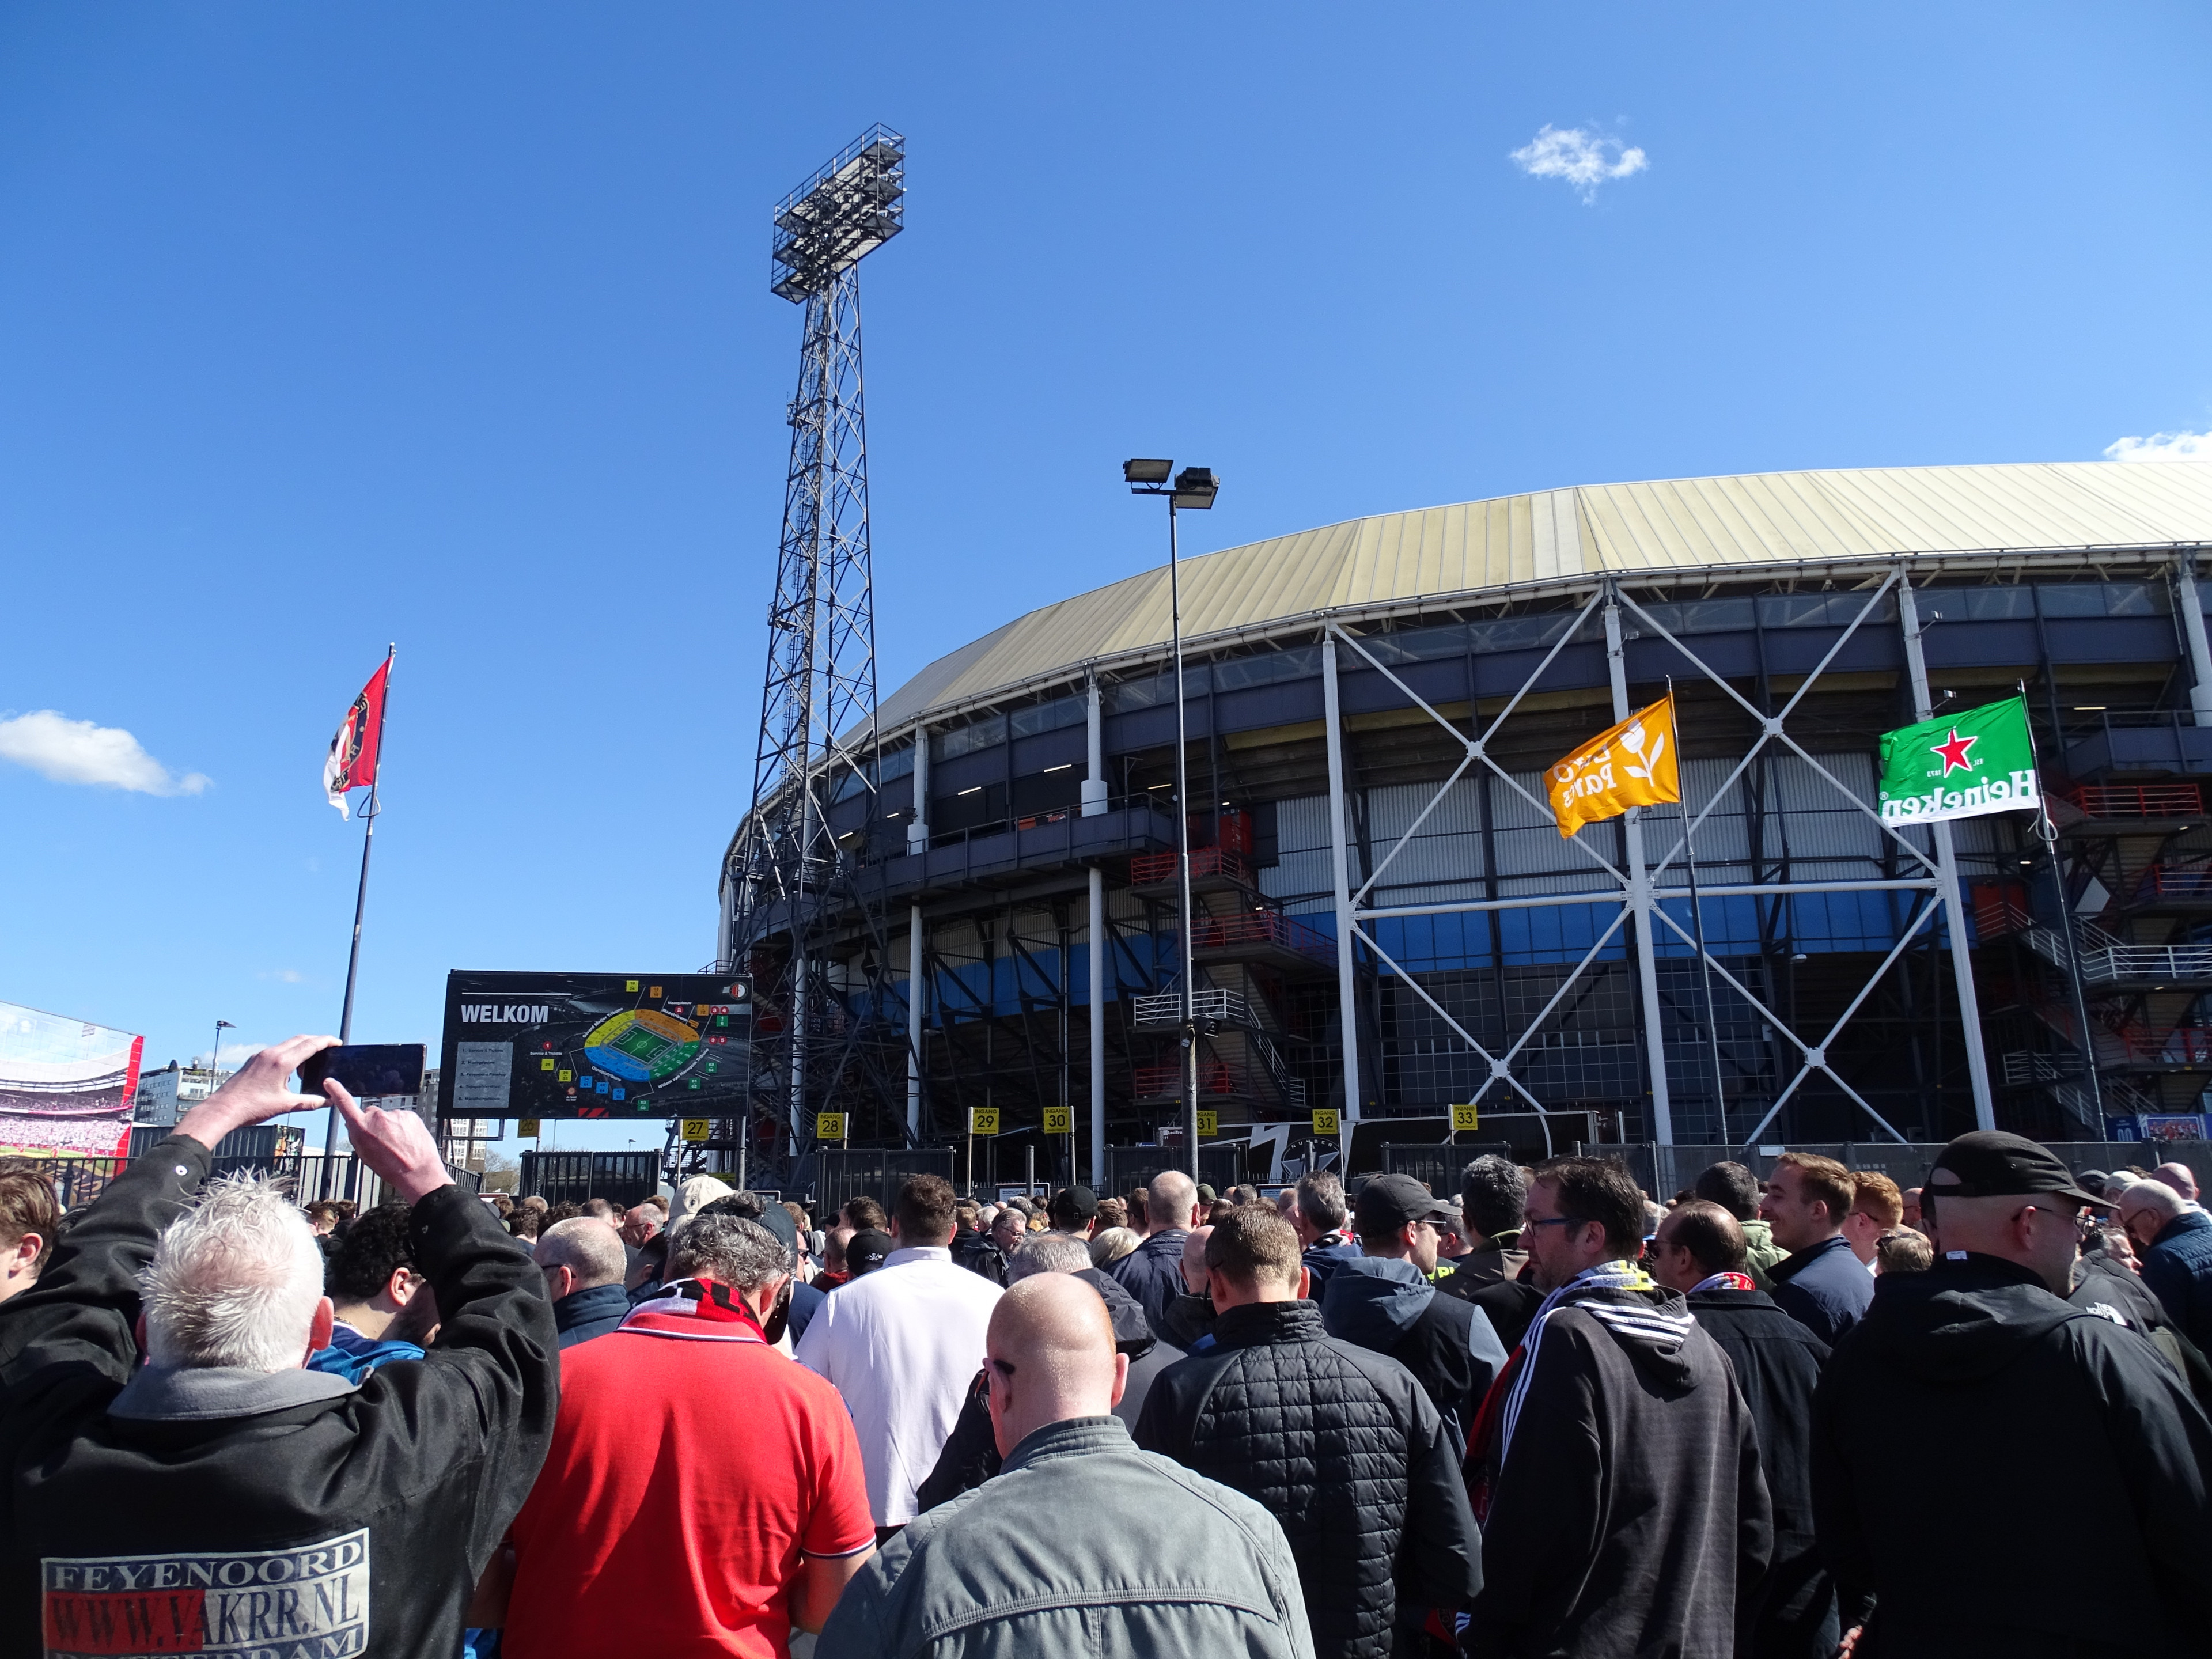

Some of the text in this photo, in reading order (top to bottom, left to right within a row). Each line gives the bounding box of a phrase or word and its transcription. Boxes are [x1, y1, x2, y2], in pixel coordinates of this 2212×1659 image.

[461, 1005, 548, 1023] WELKOM
[977, 1115, 994, 1128] 29
[1048, 1115, 1065, 1127] 30
[1198, 1118, 1210, 1130] 31
[1317, 1116, 1333, 1128] 32
[1457, 1112, 1473, 1124] 33
[521, 1119, 534, 1131] 26
[687, 1122, 703, 1134] 27
[822, 1120, 838, 1133] 28
[2085, 1306, 2112, 1316] NORTH
[2094, 1302, 2109, 1310] THE
[54, 1541, 362, 1591] FEYENOORD
[51, 1573, 362, 1649] WWW.VAKRR.NL
